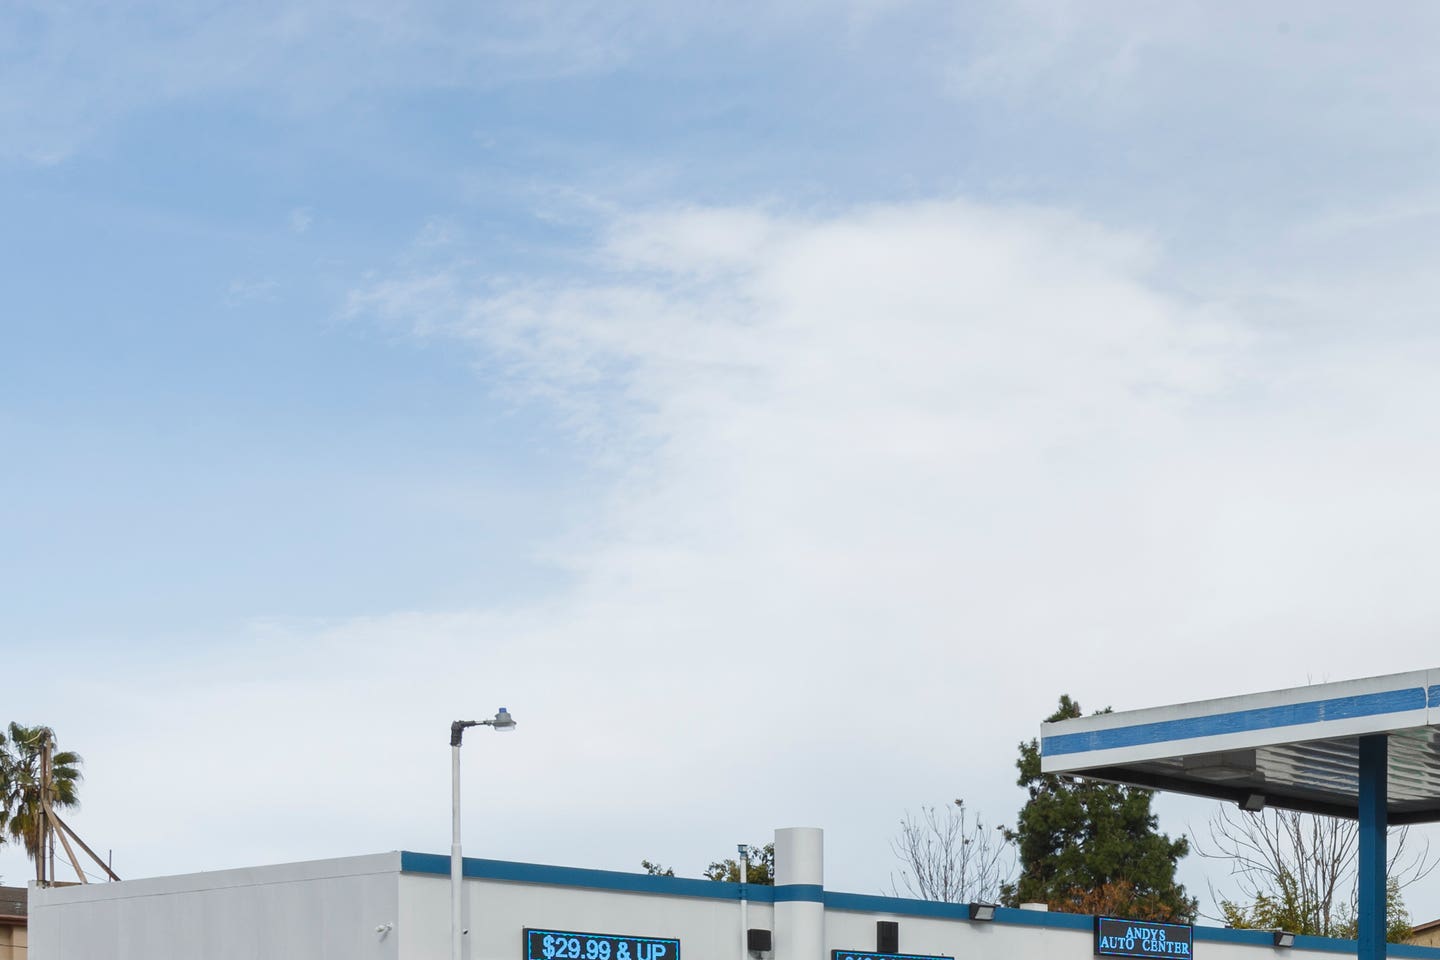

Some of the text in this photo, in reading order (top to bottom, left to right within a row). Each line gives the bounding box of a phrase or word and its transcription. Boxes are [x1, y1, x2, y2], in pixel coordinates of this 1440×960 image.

[1126, 927, 1166, 942] ANDYS
[542, 935, 611, 960] $29.99
[1100, 936, 1190, 955] AUTO CENTER
